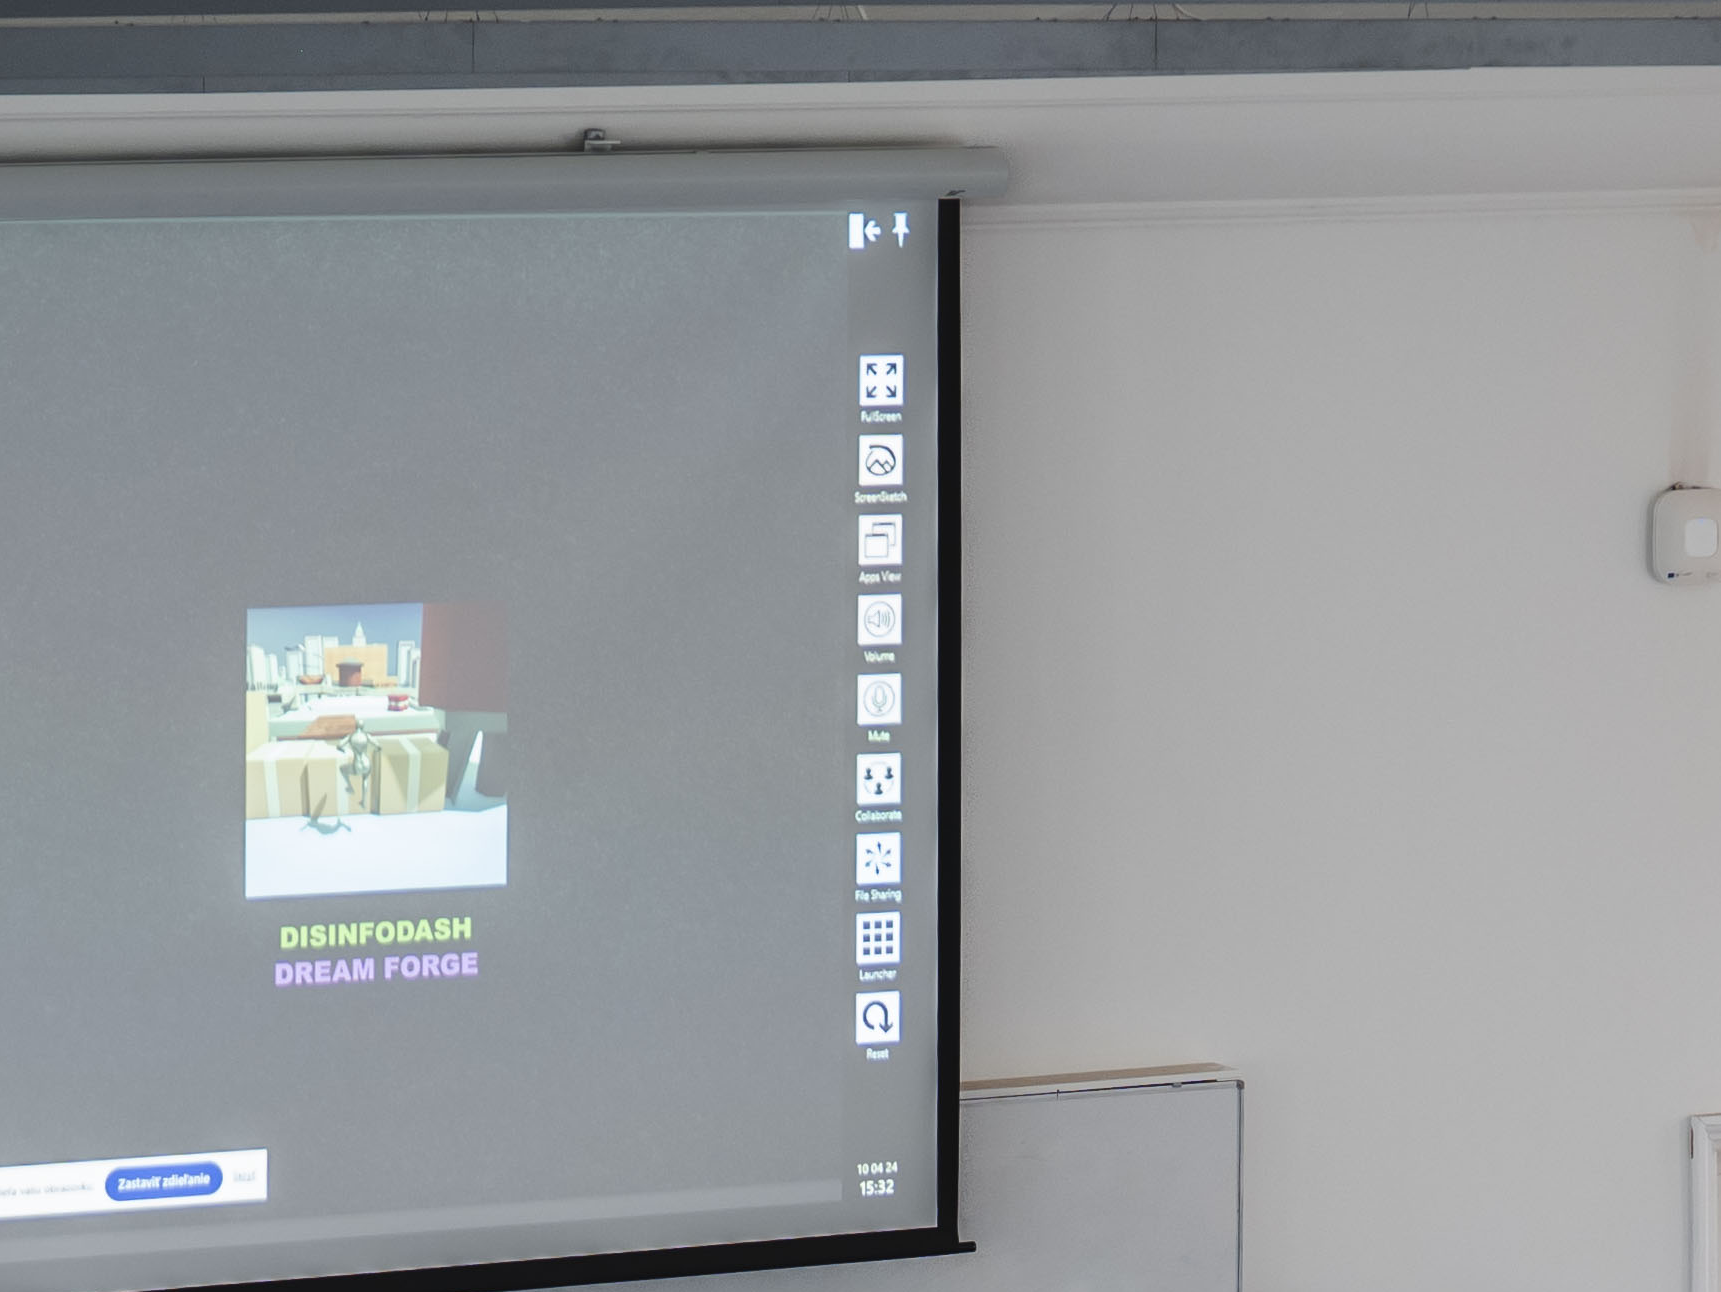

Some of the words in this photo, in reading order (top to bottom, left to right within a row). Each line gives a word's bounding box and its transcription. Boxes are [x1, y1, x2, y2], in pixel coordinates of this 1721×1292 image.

[863, 650, 895, 663] Volume
[280, 916, 472, 949] DISINFODASH
[274, 957, 375, 987] DREAM
[384, 952, 478, 980] FORGE
[859, 1178, 895, 1195] 15:32
